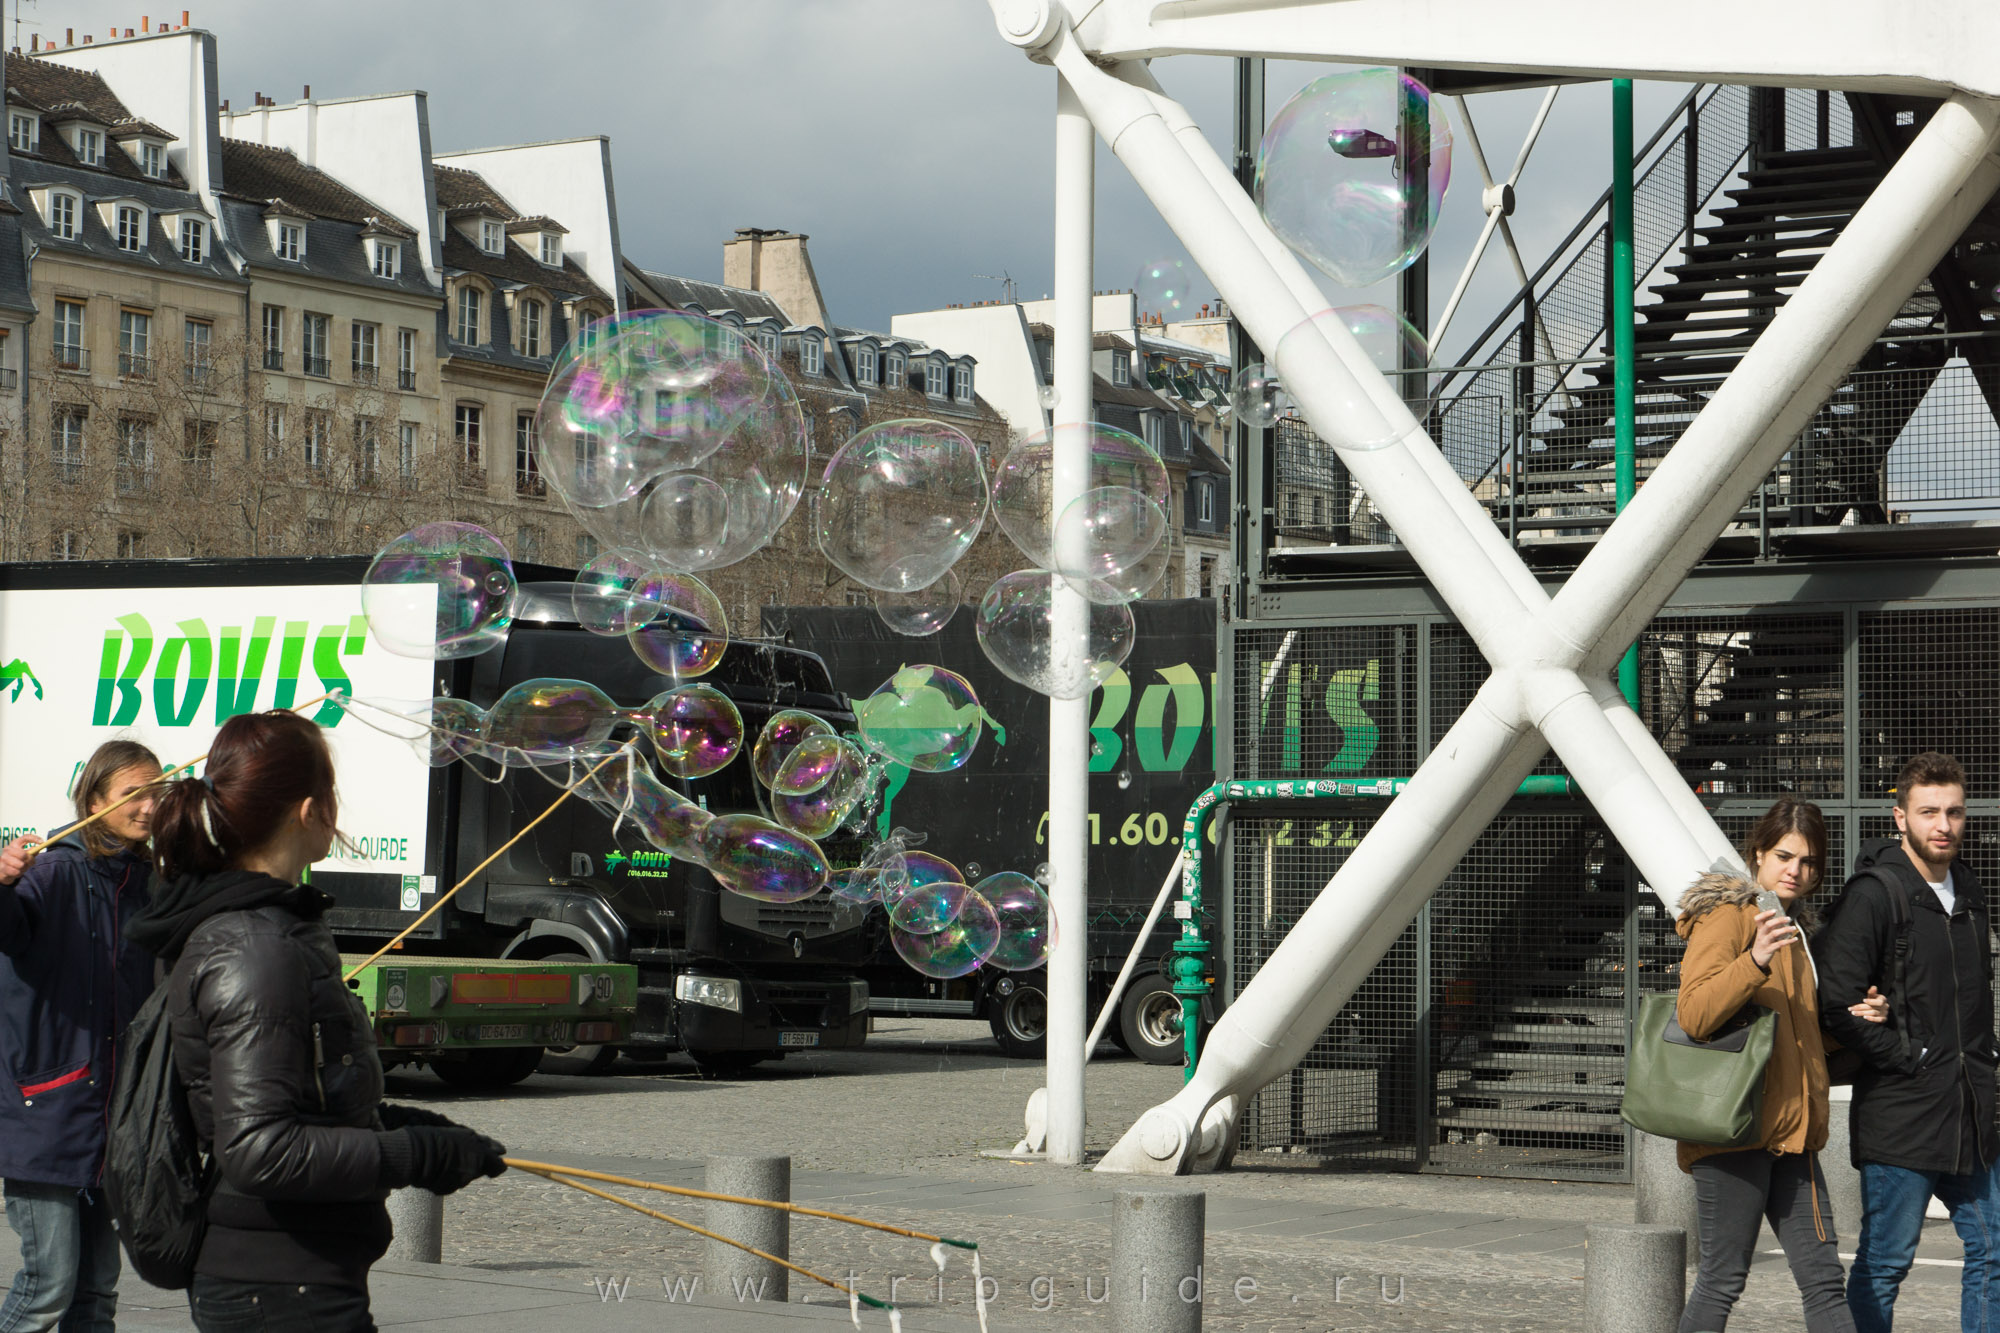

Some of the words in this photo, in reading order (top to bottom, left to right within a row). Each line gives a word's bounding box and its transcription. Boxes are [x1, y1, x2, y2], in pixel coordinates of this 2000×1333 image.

[92, 612, 370, 728] BOVIS
[352, 836, 408, 861] LOURDE
[631, 850, 672, 868] BOVIS
[597, 976, 612, 1000] 90
[551, 1019, 569, 1042] 80
